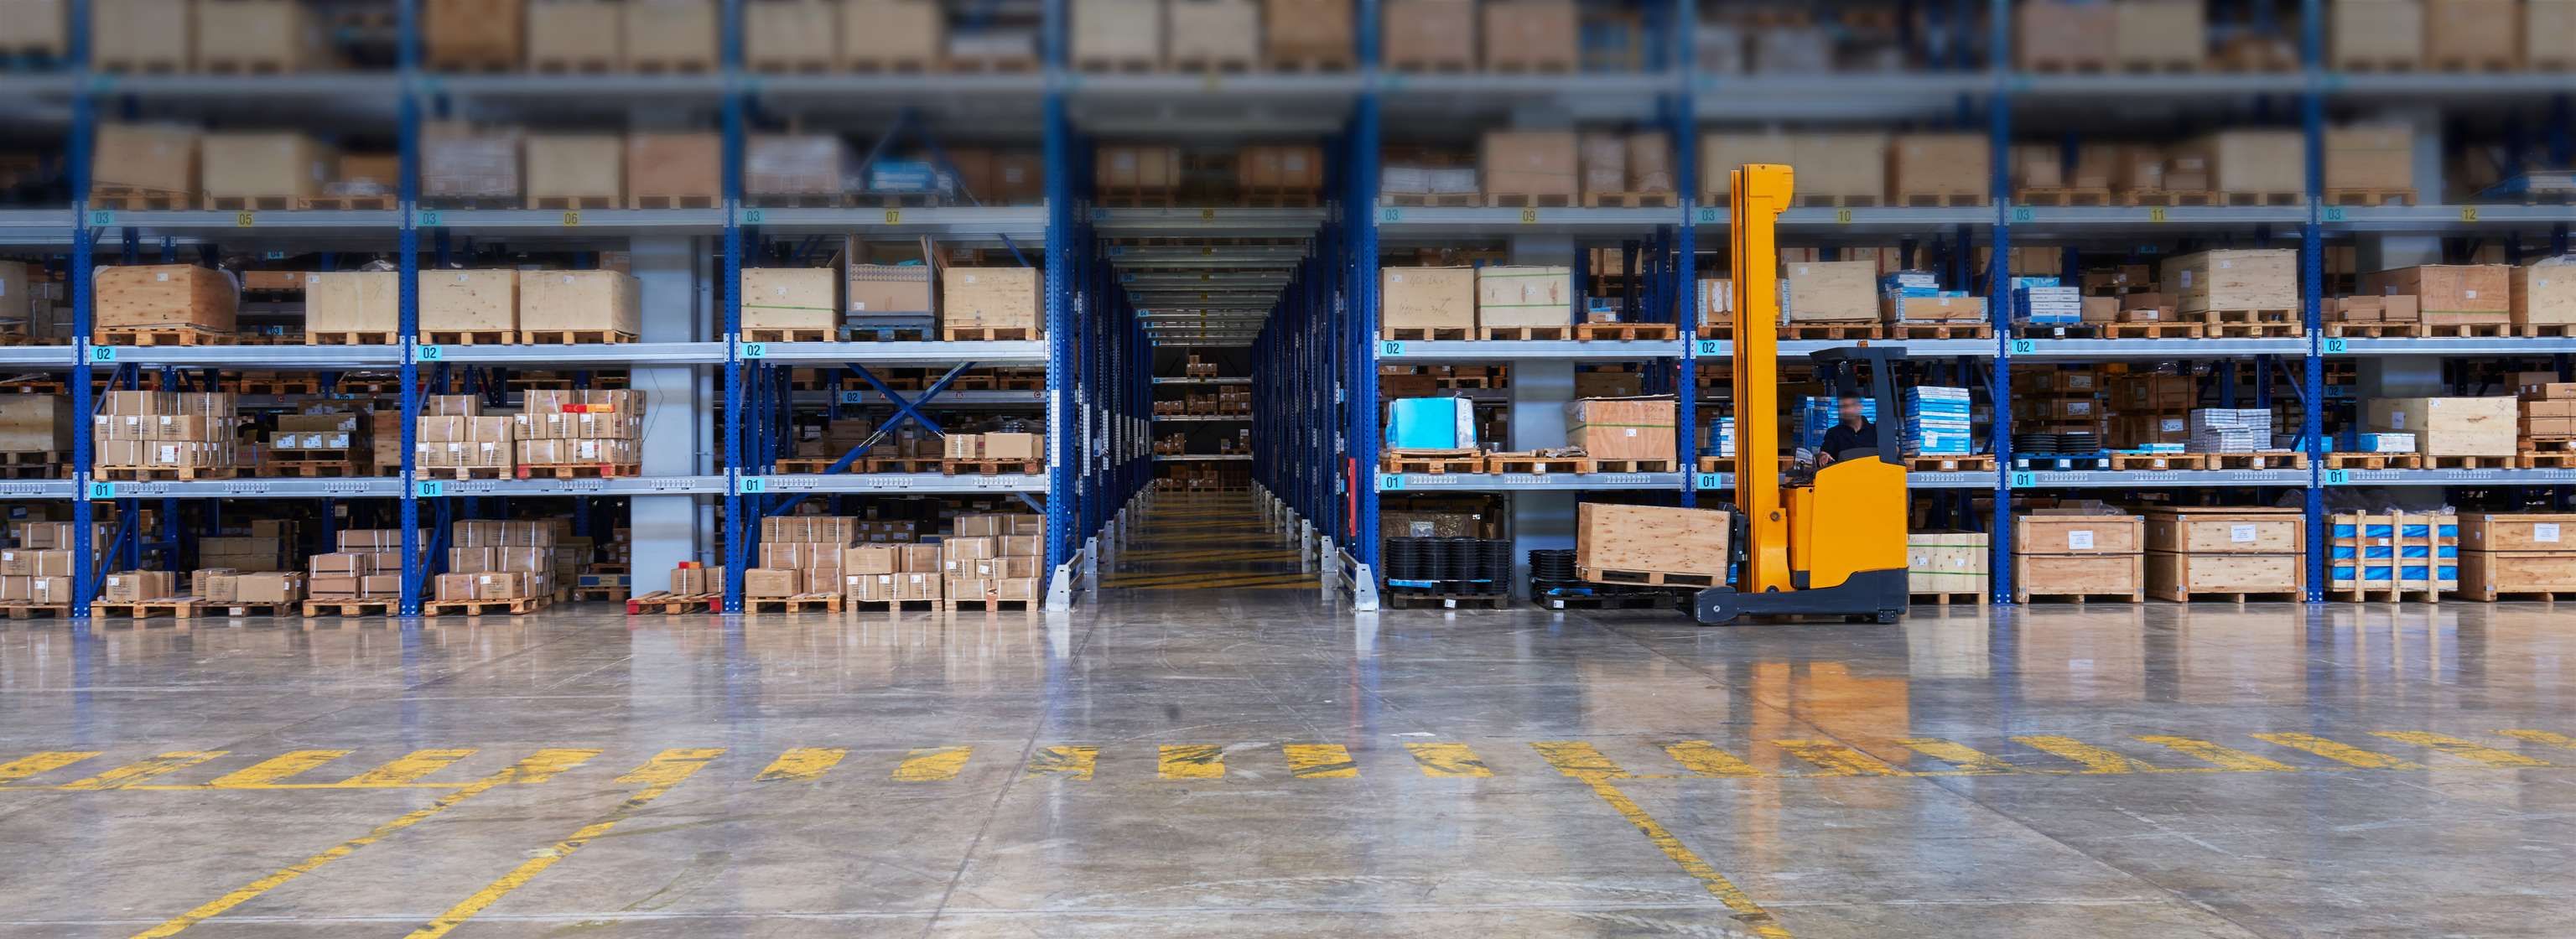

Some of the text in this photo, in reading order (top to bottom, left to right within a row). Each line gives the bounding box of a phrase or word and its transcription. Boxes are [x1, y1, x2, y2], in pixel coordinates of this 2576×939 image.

[95, 210, 110, 224] 03
[239, 213, 252, 226] 05
[423, 212, 437, 225] 03
[564, 212, 578, 225] 06
[746, 210, 760, 222] 03
[886, 210, 900, 222] 07
[1385, 207, 1399, 221] 03
[1522, 208, 1536, 222] 09
[1702, 208, 1715, 221] 03
[1839, 210, 1852, 222] 10
[2017, 208, 2030, 220] 03
[2152, 208, 2164, 220] 11
[2328, 207, 2341, 220] 03
[2463, 208, 2476, 220] 12
[747, 345, 761, 356] 02
[1386, 342, 1400, 355] 02
[1702, 341, 1716, 354] 02
[2017, 340, 2030, 353] 02
[2329, 340, 2342, 352] 02
[96, 348, 111, 360] 02
[423, 347, 437, 359] 02
[847, 392, 858, 402] 02
[2328, 386, 2339, 397] 02
[1386, 476, 1398, 488] 01
[1703, 475, 1715, 487] 01
[2017, 474, 2029, 485] 01
[2330, 471, 2342, 483] 01
[96, 484, 108, 496] 01
[423, 483, 436, 495] 01
[746, 479, 758, 491] 01
